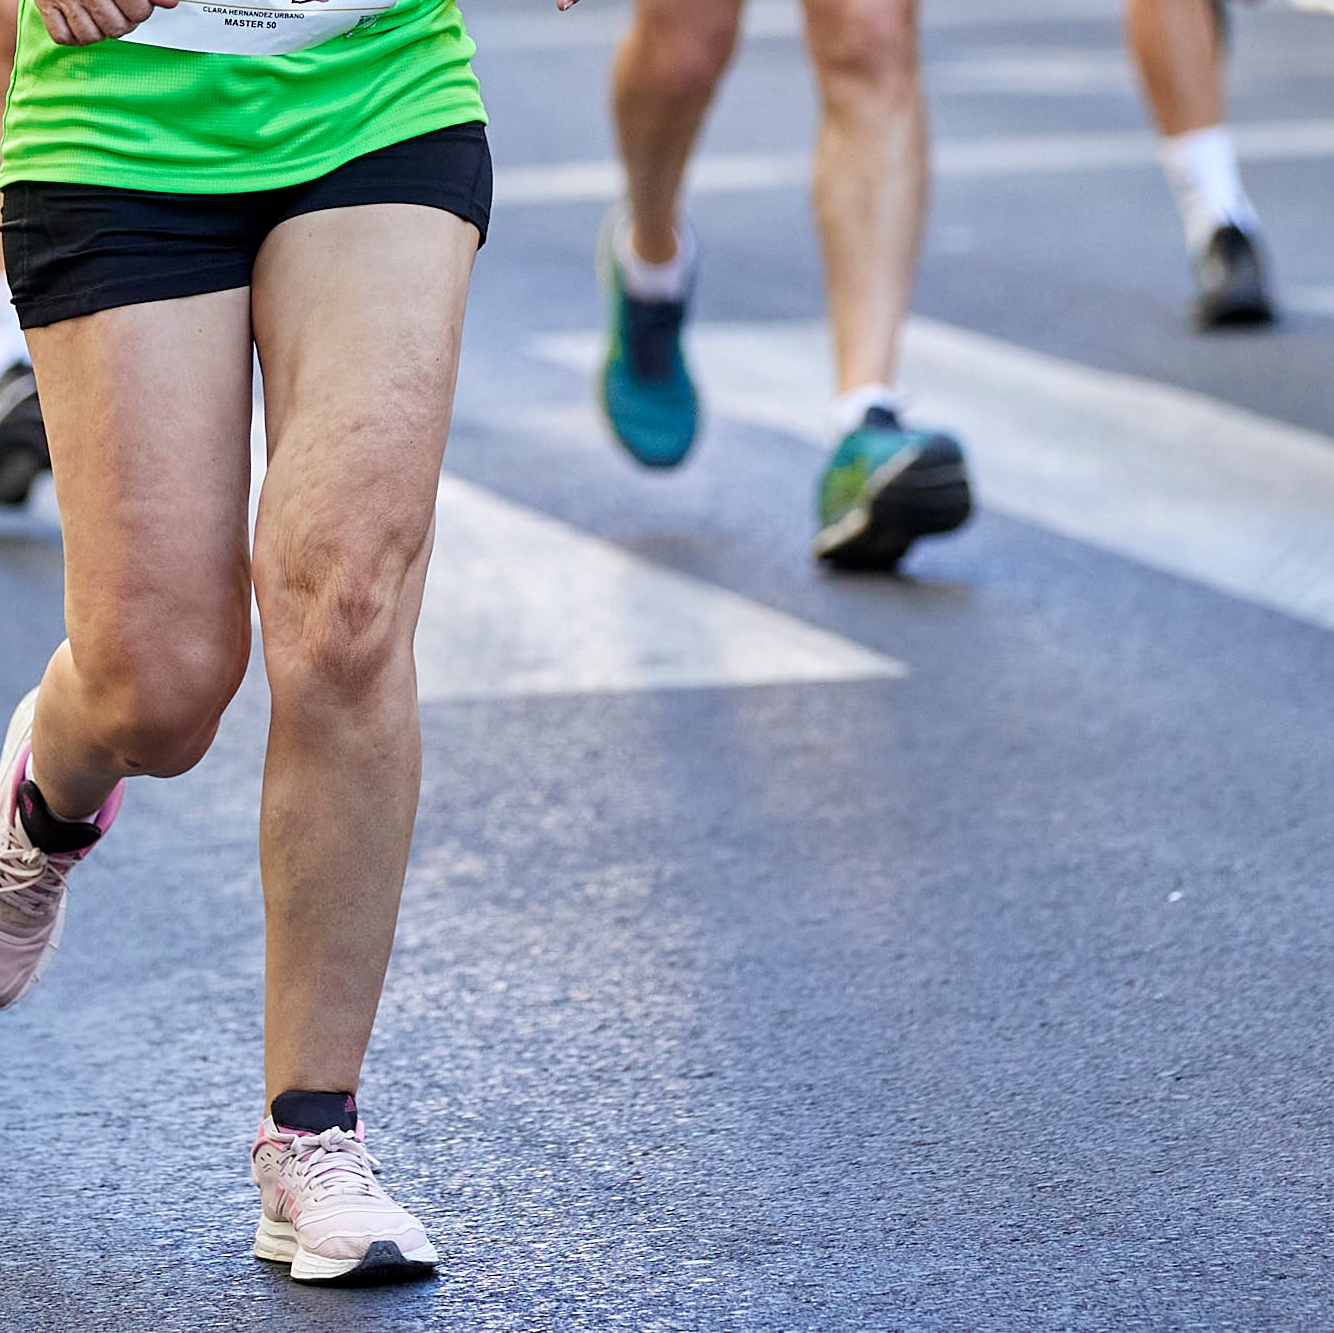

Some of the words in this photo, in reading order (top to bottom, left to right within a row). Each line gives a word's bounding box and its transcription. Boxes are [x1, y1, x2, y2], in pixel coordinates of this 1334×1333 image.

[203, 6, 228, 15] CLARA
[229, 9, 274, 19] HERNANDEZ
[275, 12, 305, 20] URBANO
[224, 18, 264, 29] MASTER
[266, 21, 277, 29] 50
